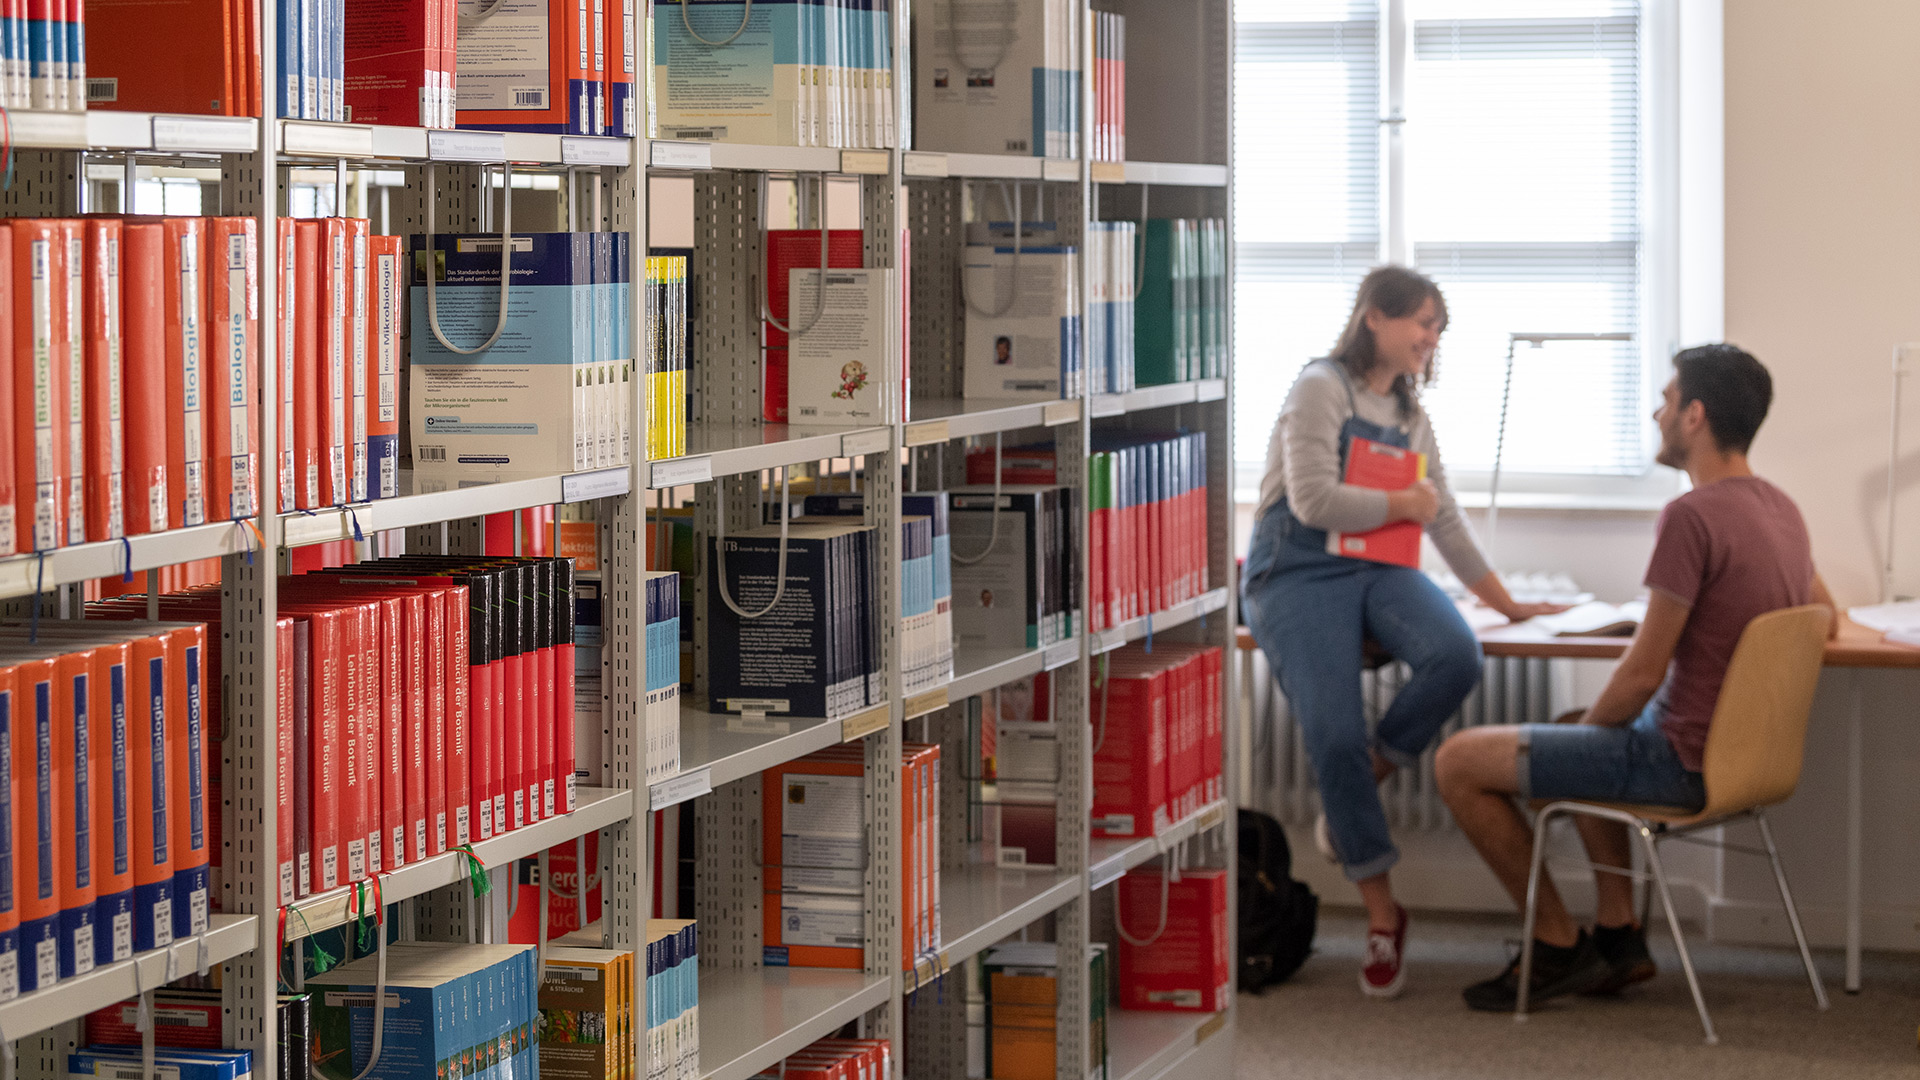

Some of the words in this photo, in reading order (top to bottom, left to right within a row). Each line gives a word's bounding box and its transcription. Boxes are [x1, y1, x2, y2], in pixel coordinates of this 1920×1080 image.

[384, 260, 392, 346] Mikrobiologie
[232, 313, 244, 402] Biologie
[235, 460, 245, 470] bio
[77, 714, 88, 783] Biologie
[114, 703, 125, 771] Biologie
[153, 695, 164, 762] Biologie
[190, 684, 199, 750] Biologie
[348, 739, 356, 786] Botanik
